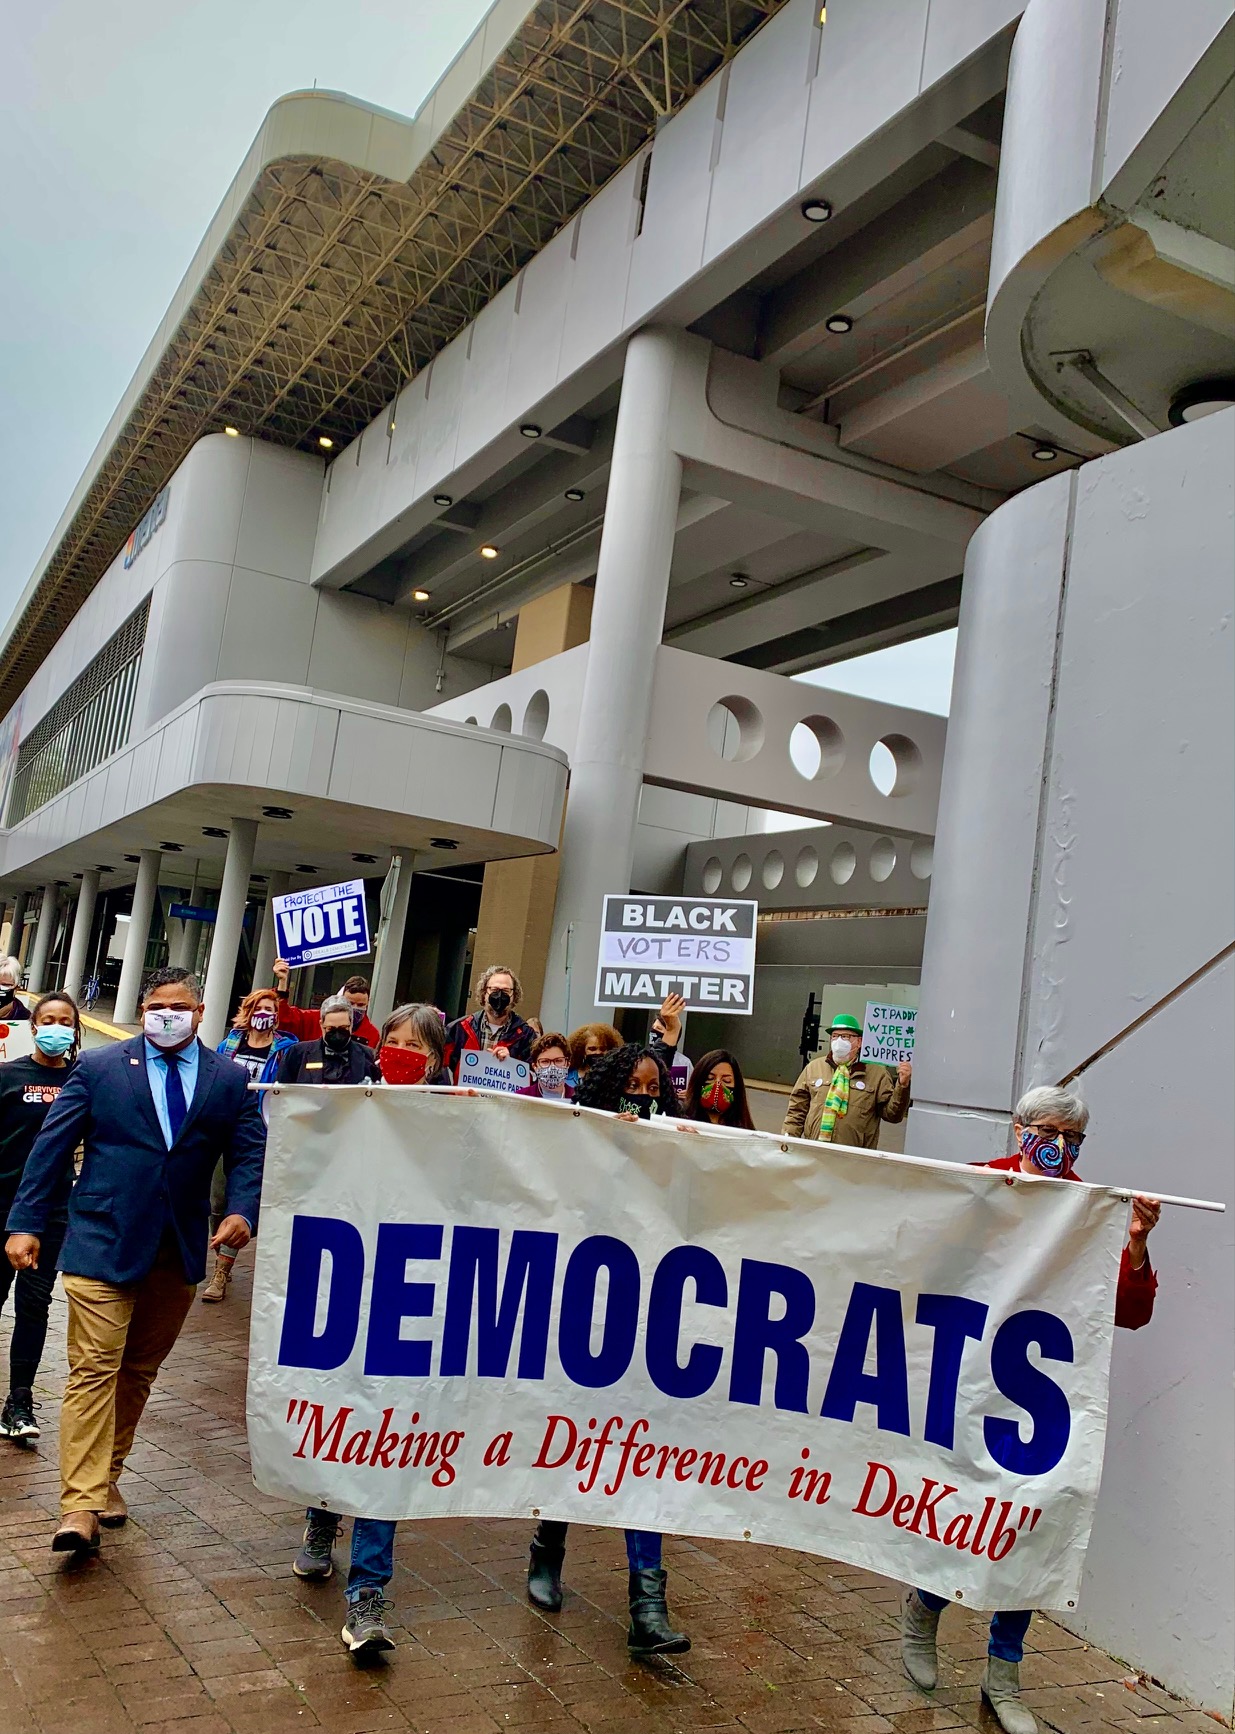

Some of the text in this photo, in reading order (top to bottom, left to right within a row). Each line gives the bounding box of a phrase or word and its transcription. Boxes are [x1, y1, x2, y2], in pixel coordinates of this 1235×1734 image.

[283, 884, 354, 908] PROTECT THE
[280, 898, 361, 948] VOTE
[622, 903, 738, 932] BLACK
[617, 937, 731, 962] VOTERS
[604, 972, 746, 1003] MATTER
[250, 1015, 274, 1030] VOTE
[867, 1022, 903, 1036] WIPE
[875, 1035, 915, 1049] VOTE
[462, 1074, 507, 1091] DEMOCRATIC
[484, 1066, 511, 1080] DEKALB
[277, 1214, 1074, 1476] DEMOCRATS
[286, 1399, 1042, 1561] "Making a Difference in DeKalb"
